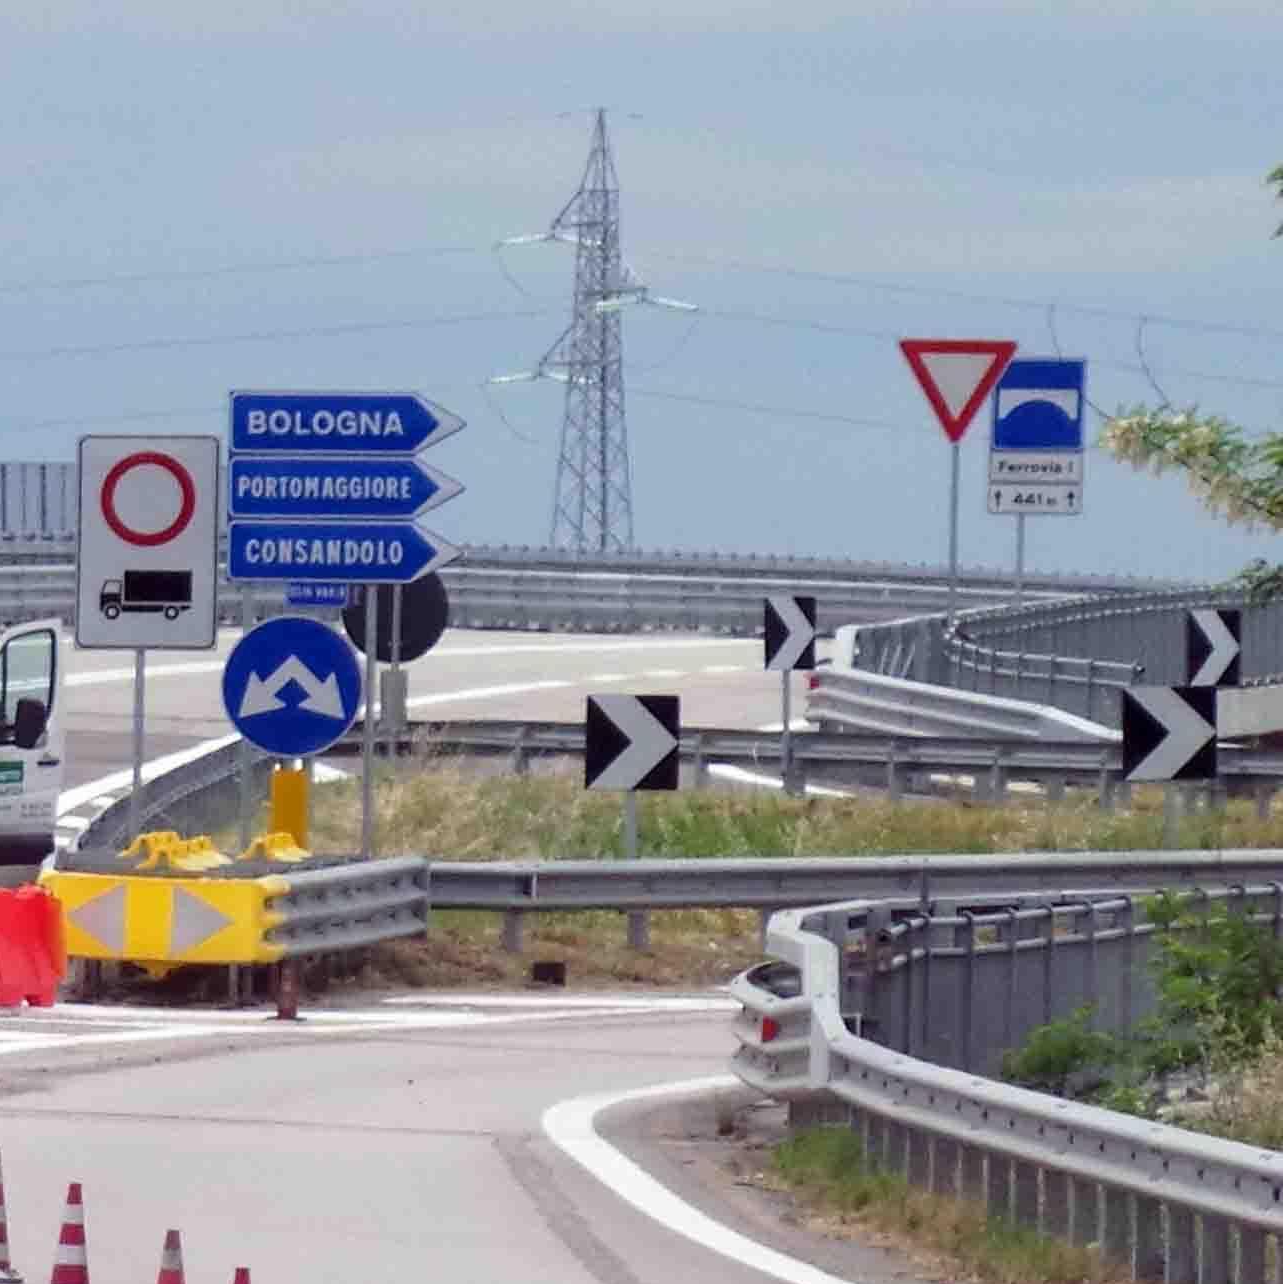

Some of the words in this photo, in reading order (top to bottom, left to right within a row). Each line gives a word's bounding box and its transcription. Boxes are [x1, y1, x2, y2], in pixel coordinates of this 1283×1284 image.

[247, 410, 405, 437] BOLOGNA
[238, 474, 412, 500] PORTOMAGGIORE
[244, 539, 404, 567] CONSANDOLO
